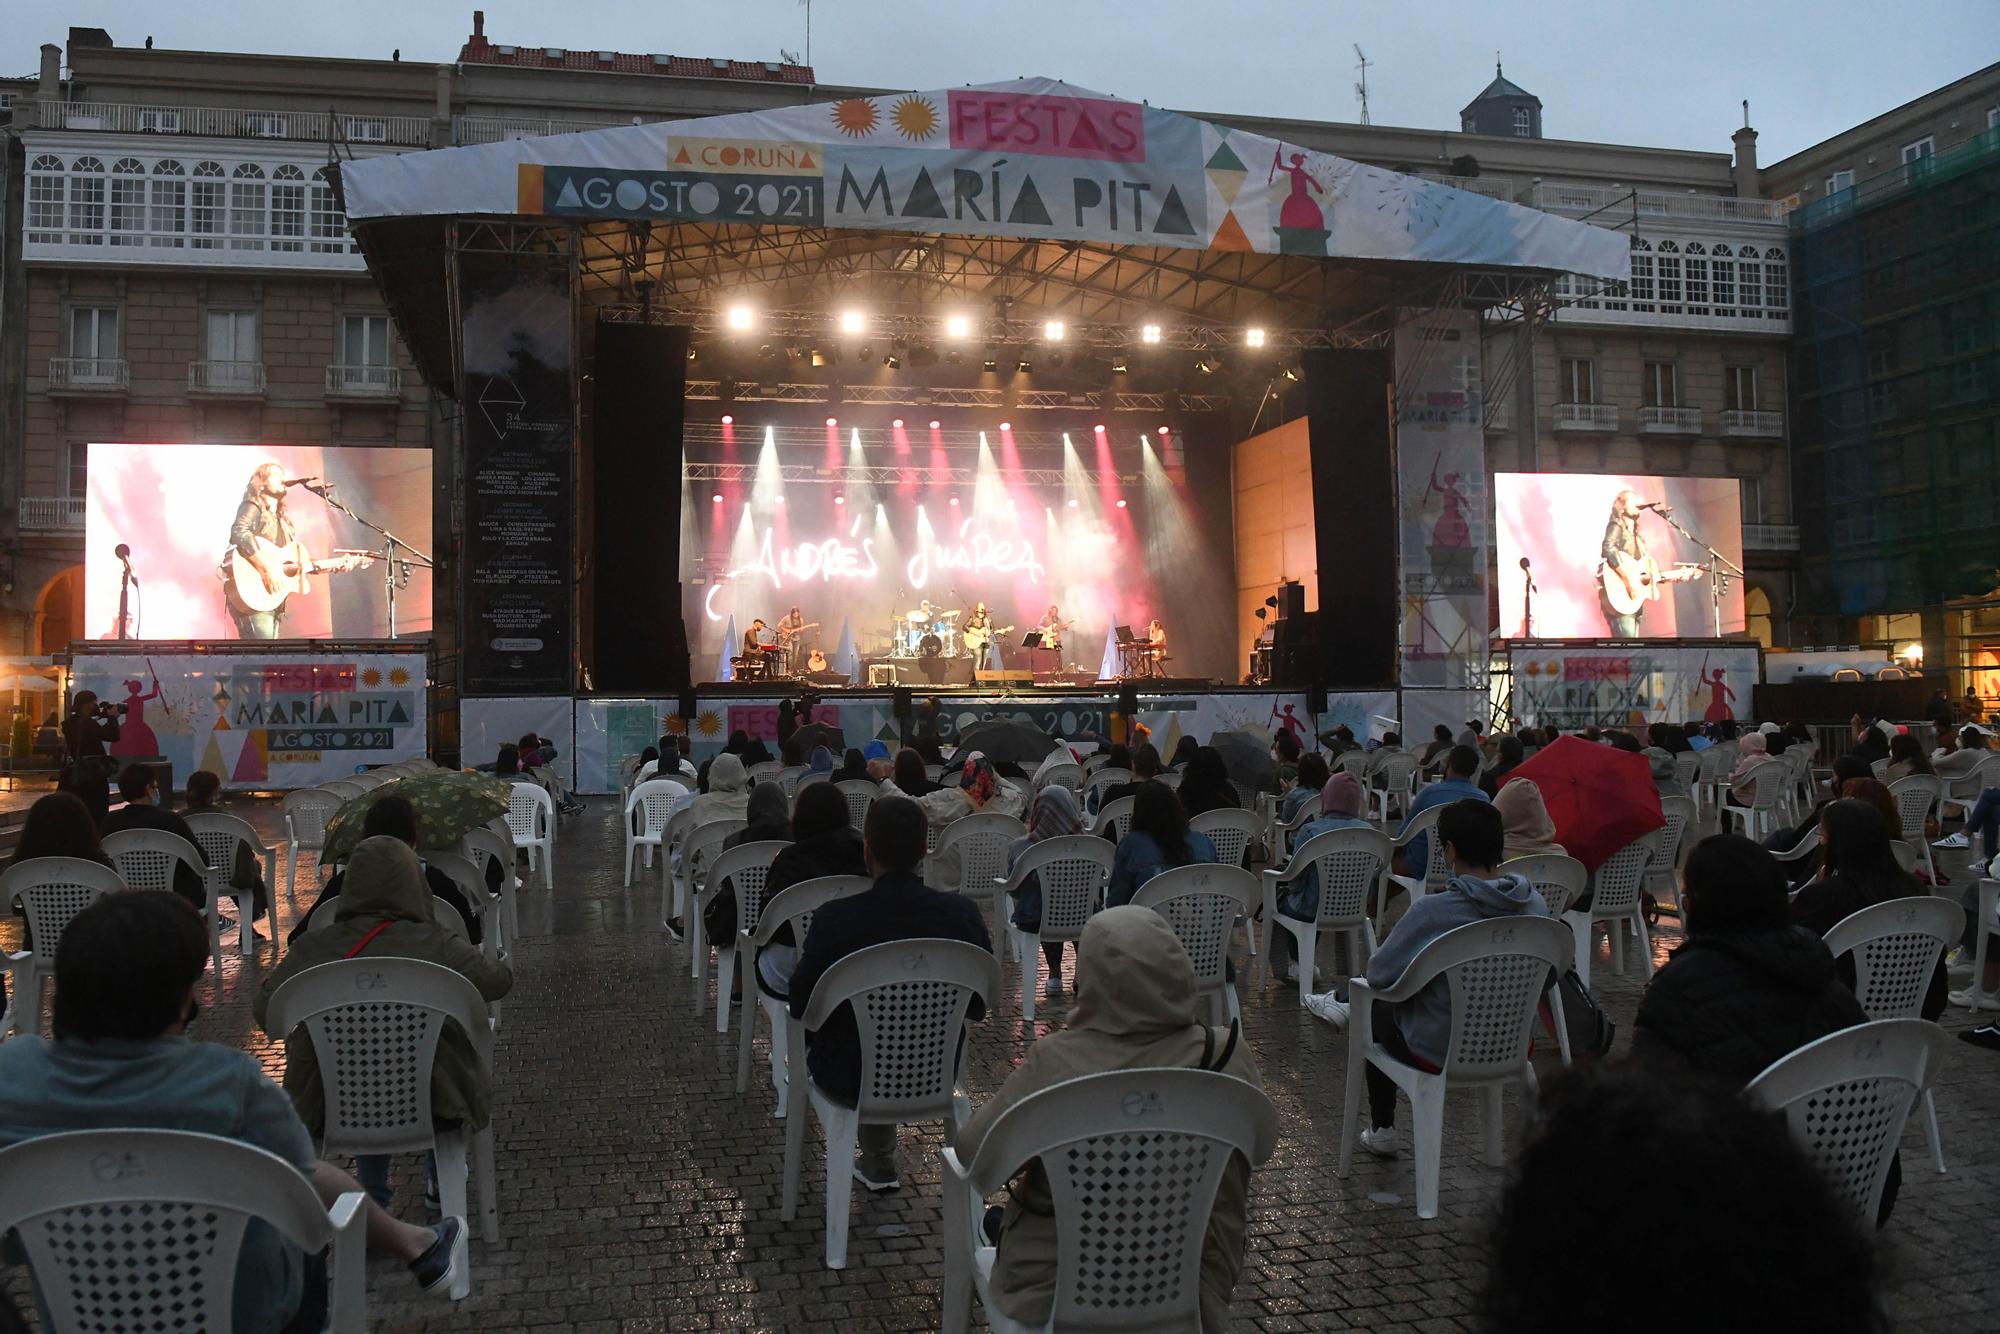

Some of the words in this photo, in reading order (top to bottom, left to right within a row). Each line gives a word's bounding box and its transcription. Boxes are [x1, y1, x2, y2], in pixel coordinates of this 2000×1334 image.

[956, 98, 1138, 154] FESTAS
[673, 145, 693, 165] A
[701, 143, 817, 170] CORUÑA
[554, 175, 720, 215] AGOSTO
[733, 183, 815, 218] 2021
[836, 159, 1053, 226] MARÍA
[1073, 178, 1198, 236] PITA
[236, 692, 339, 725] MARÍA
[349, 699, 409, 723] PITA
[1044, 710, 1103, 735] 2021
[273, 733, 346, 748] AGOSTO
[352, 732, 390, 746] 2021
